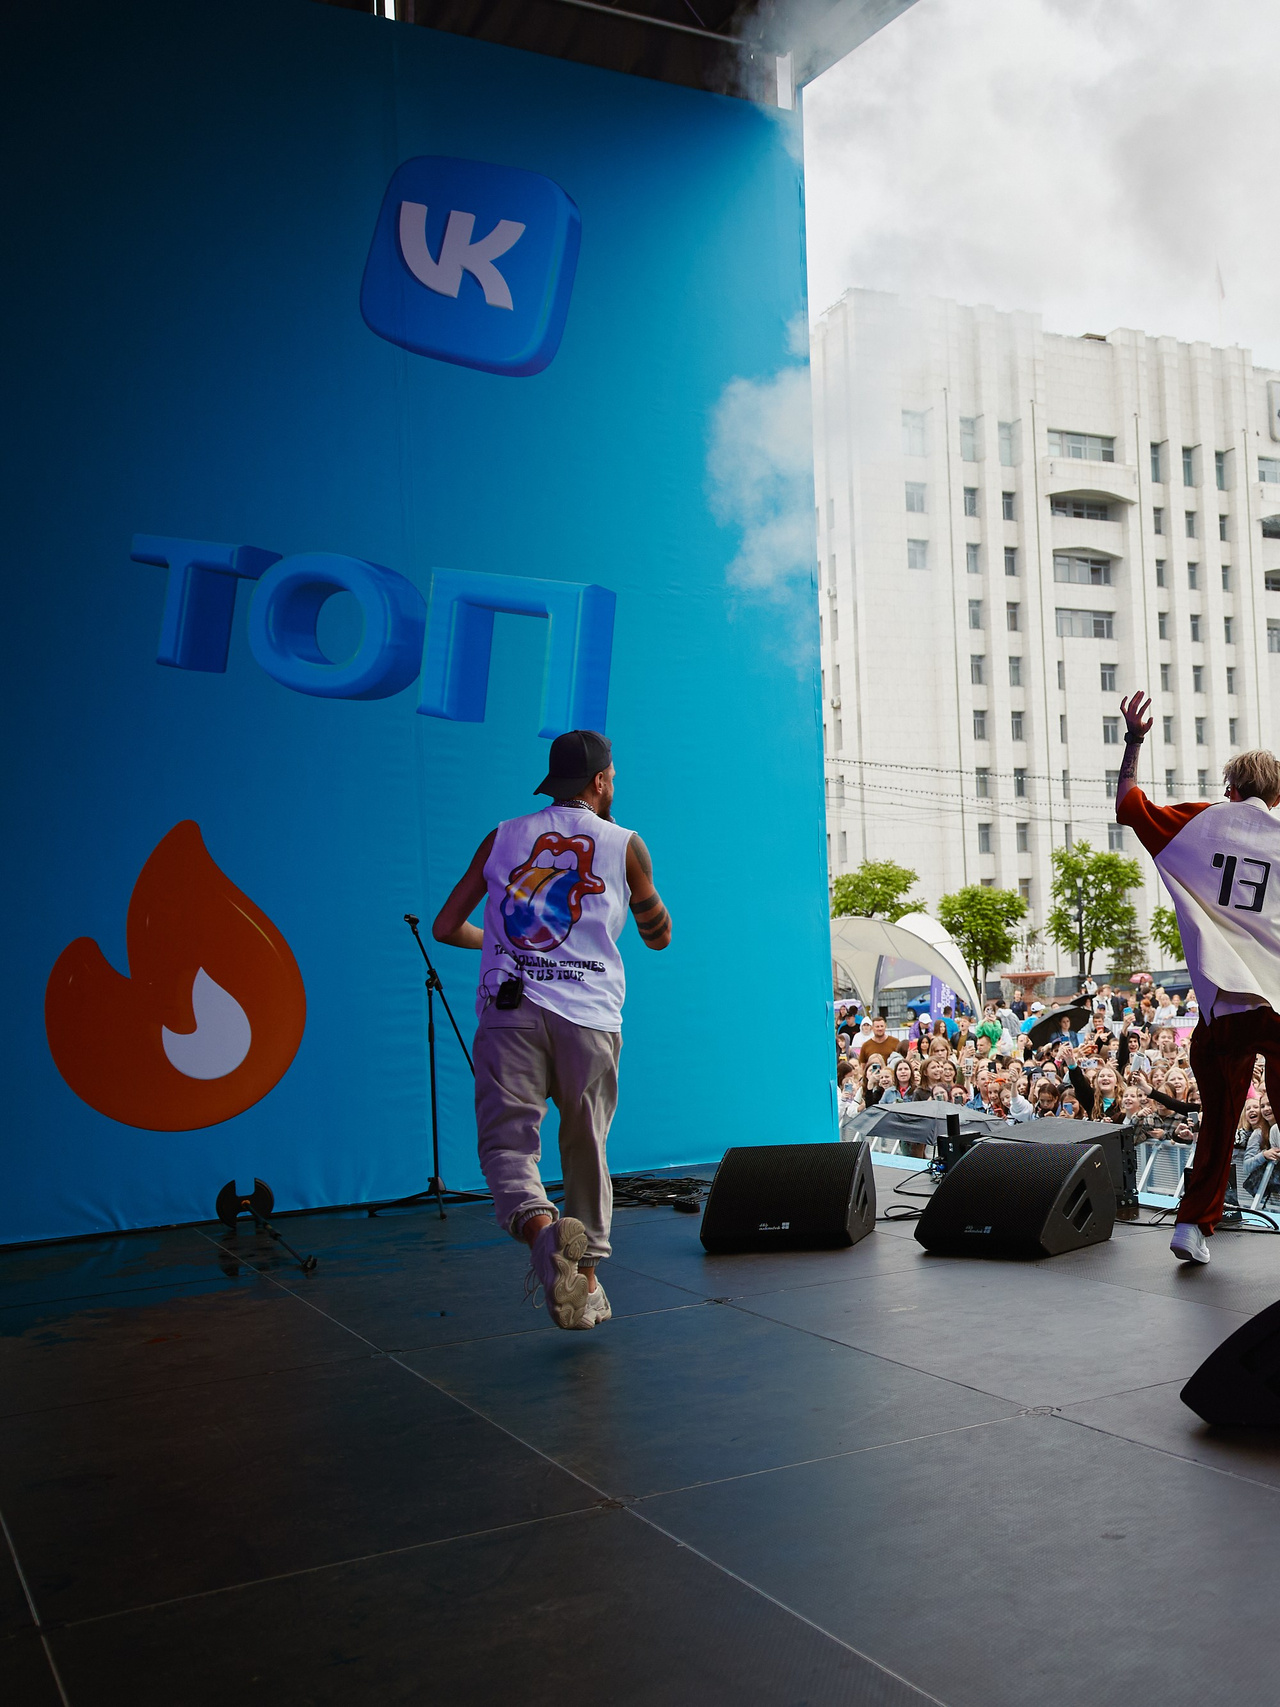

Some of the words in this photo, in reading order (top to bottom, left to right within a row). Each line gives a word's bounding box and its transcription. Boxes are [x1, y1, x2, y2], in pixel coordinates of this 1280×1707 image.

[399, 200, 526, 311] VK
[131, 533, 616, 740] ТОП
[556, 969, 585, 982] TOUR
[559, 960, 606, 973] STONES
